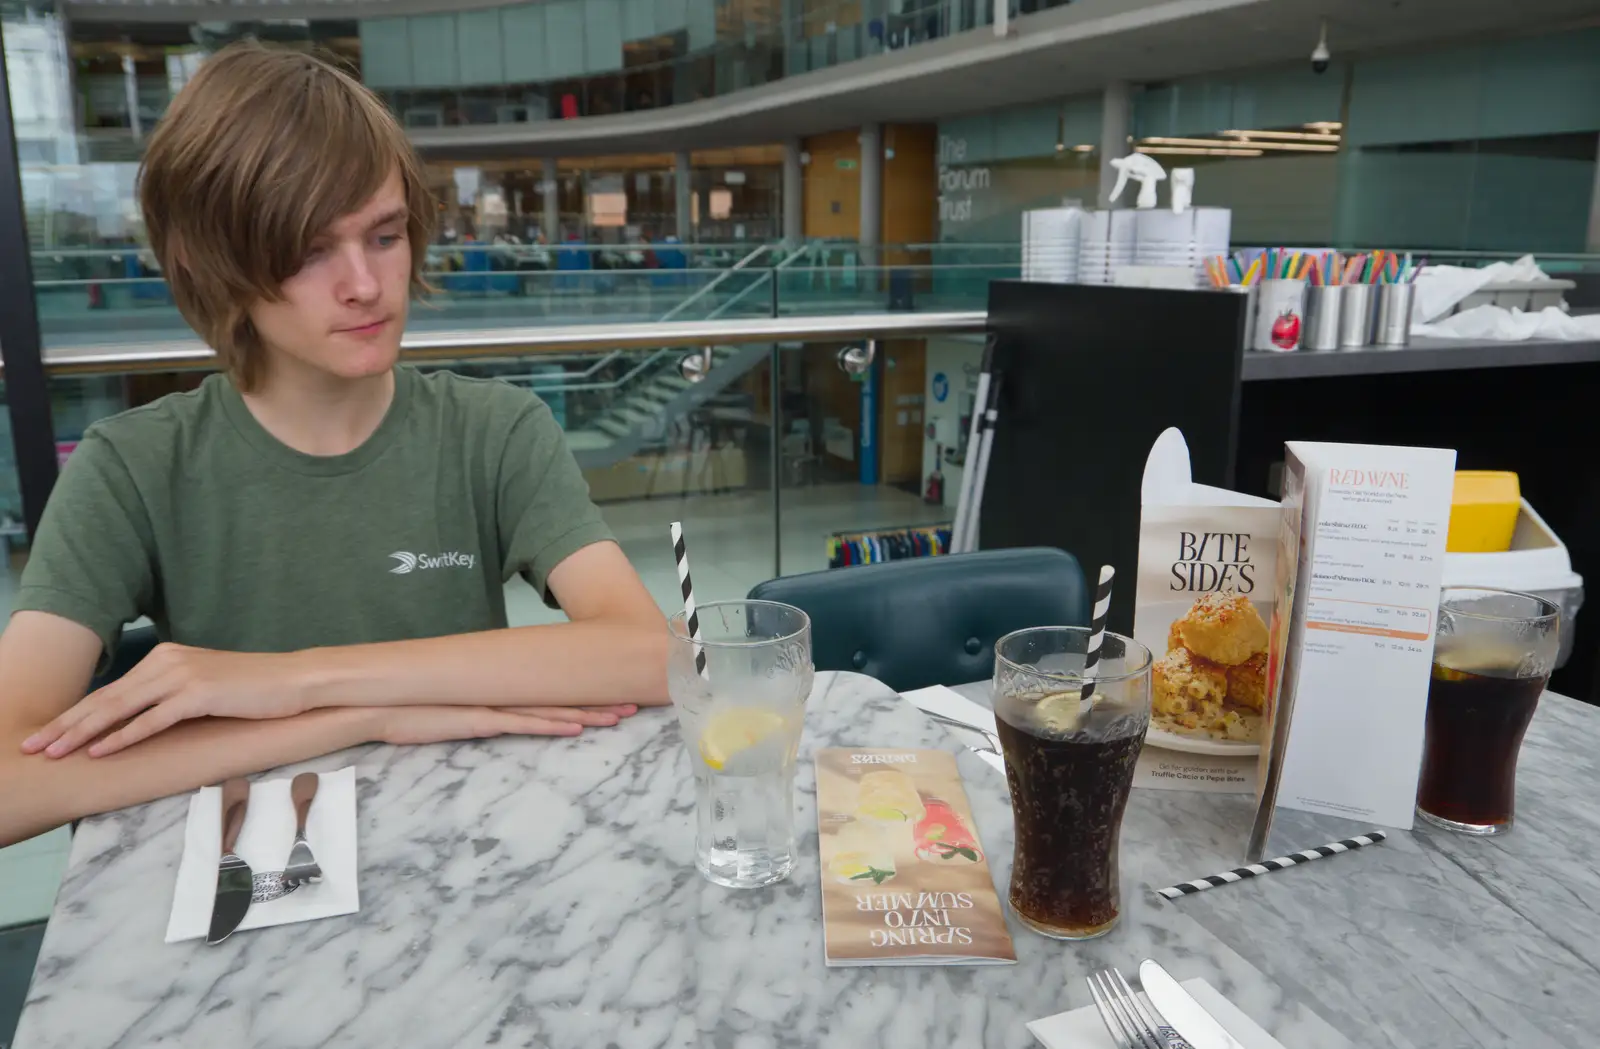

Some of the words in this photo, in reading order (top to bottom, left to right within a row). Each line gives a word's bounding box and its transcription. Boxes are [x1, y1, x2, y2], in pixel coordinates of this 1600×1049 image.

[939, 165, 990, 191] Forum
[937, 195, 972, 221] Trust
[1330, 468, 1365, 487] RED
[1367, 470, 1410, 490] WINE
[1178, 531, 1251, 563] BITE
[1170, 562, 1255, 594] SIDES
[1151, 770, 1176, 778] Truffle
[1176, 772, 1199, 780] Cacio
[1206, 775, 1225, 783] Pepe
[856, 892, 974, 912] SUMMER
[884, 910, 951, 928] INTO
[869, 926, 973, 947] SPRING
